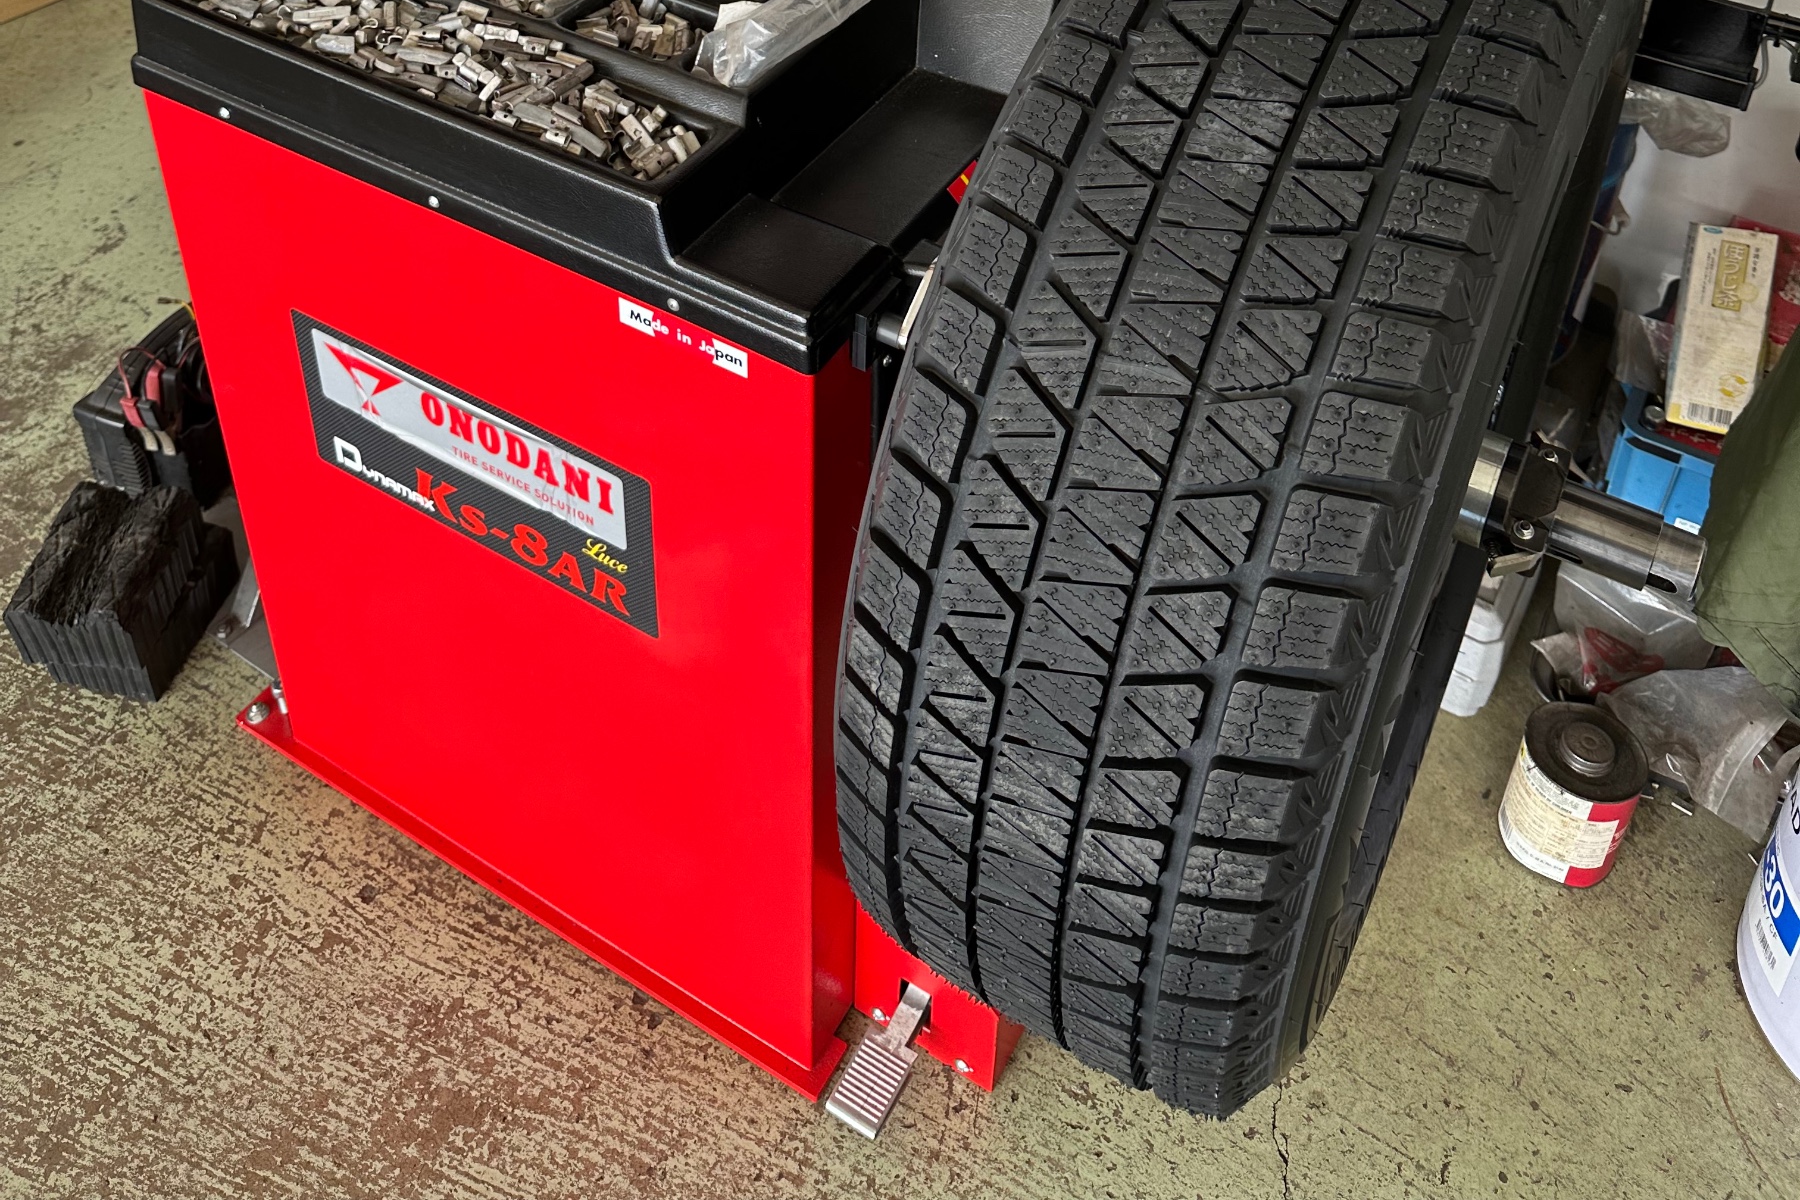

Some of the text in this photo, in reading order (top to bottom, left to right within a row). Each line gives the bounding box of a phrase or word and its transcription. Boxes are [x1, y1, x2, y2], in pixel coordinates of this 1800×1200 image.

[1716, 243, 1746, 308] ほうじ茶
[630, 309, 743, 368] Made in Japan
[420, 392, 613, 514] ONODANI
[452, 446, 596, 526] TIRE SERVICE SOLUTION
[581, 538, 628, 574] Luce
